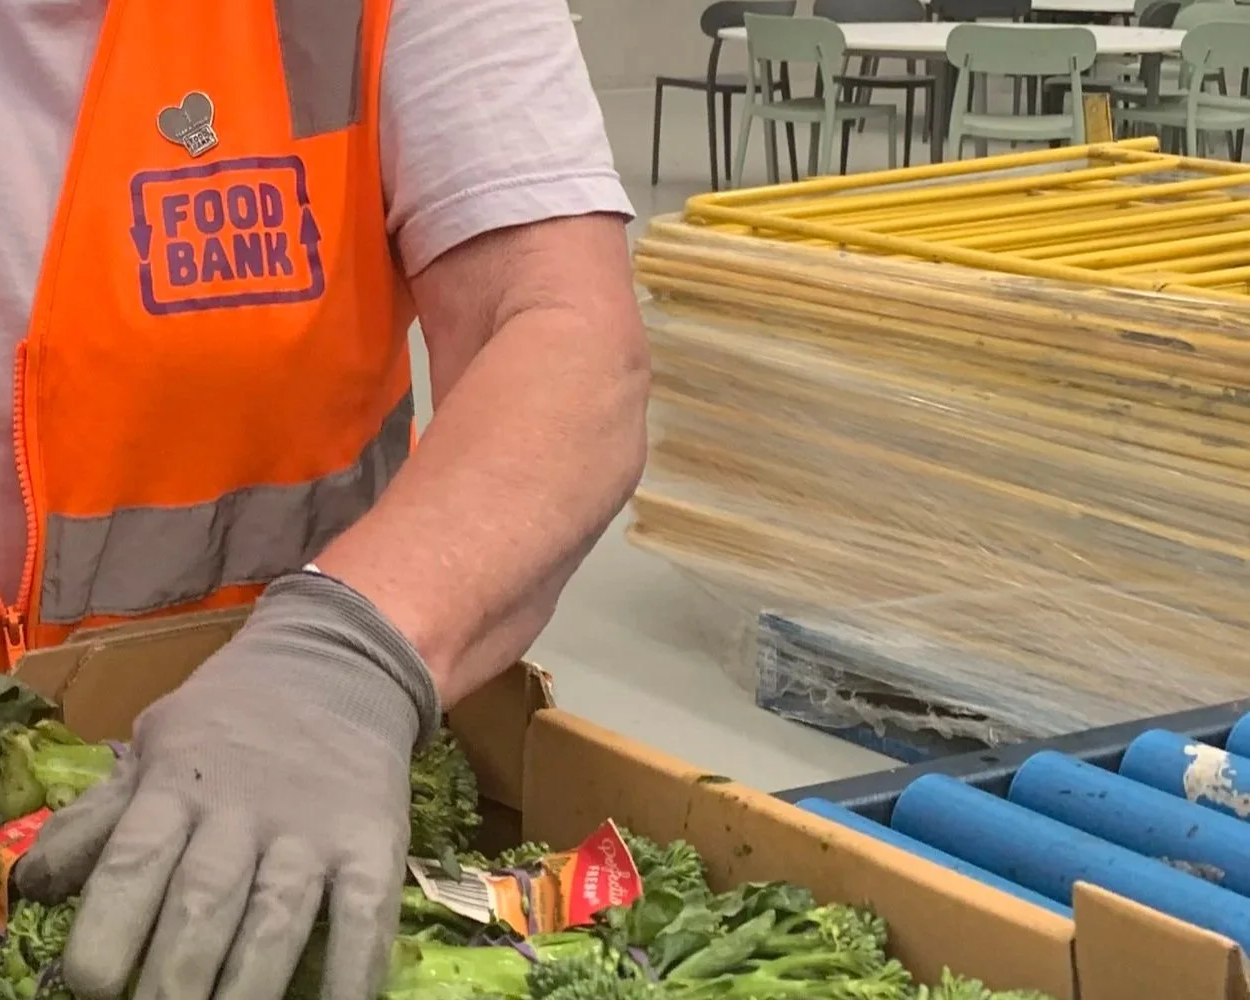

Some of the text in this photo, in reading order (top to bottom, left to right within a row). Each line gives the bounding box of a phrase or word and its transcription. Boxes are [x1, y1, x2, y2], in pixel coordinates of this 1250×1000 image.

[162, 182, 284, 238] FOOD
[166, 232, 294, 286] BANK
[598, 837, 631, 905] Perfectio
